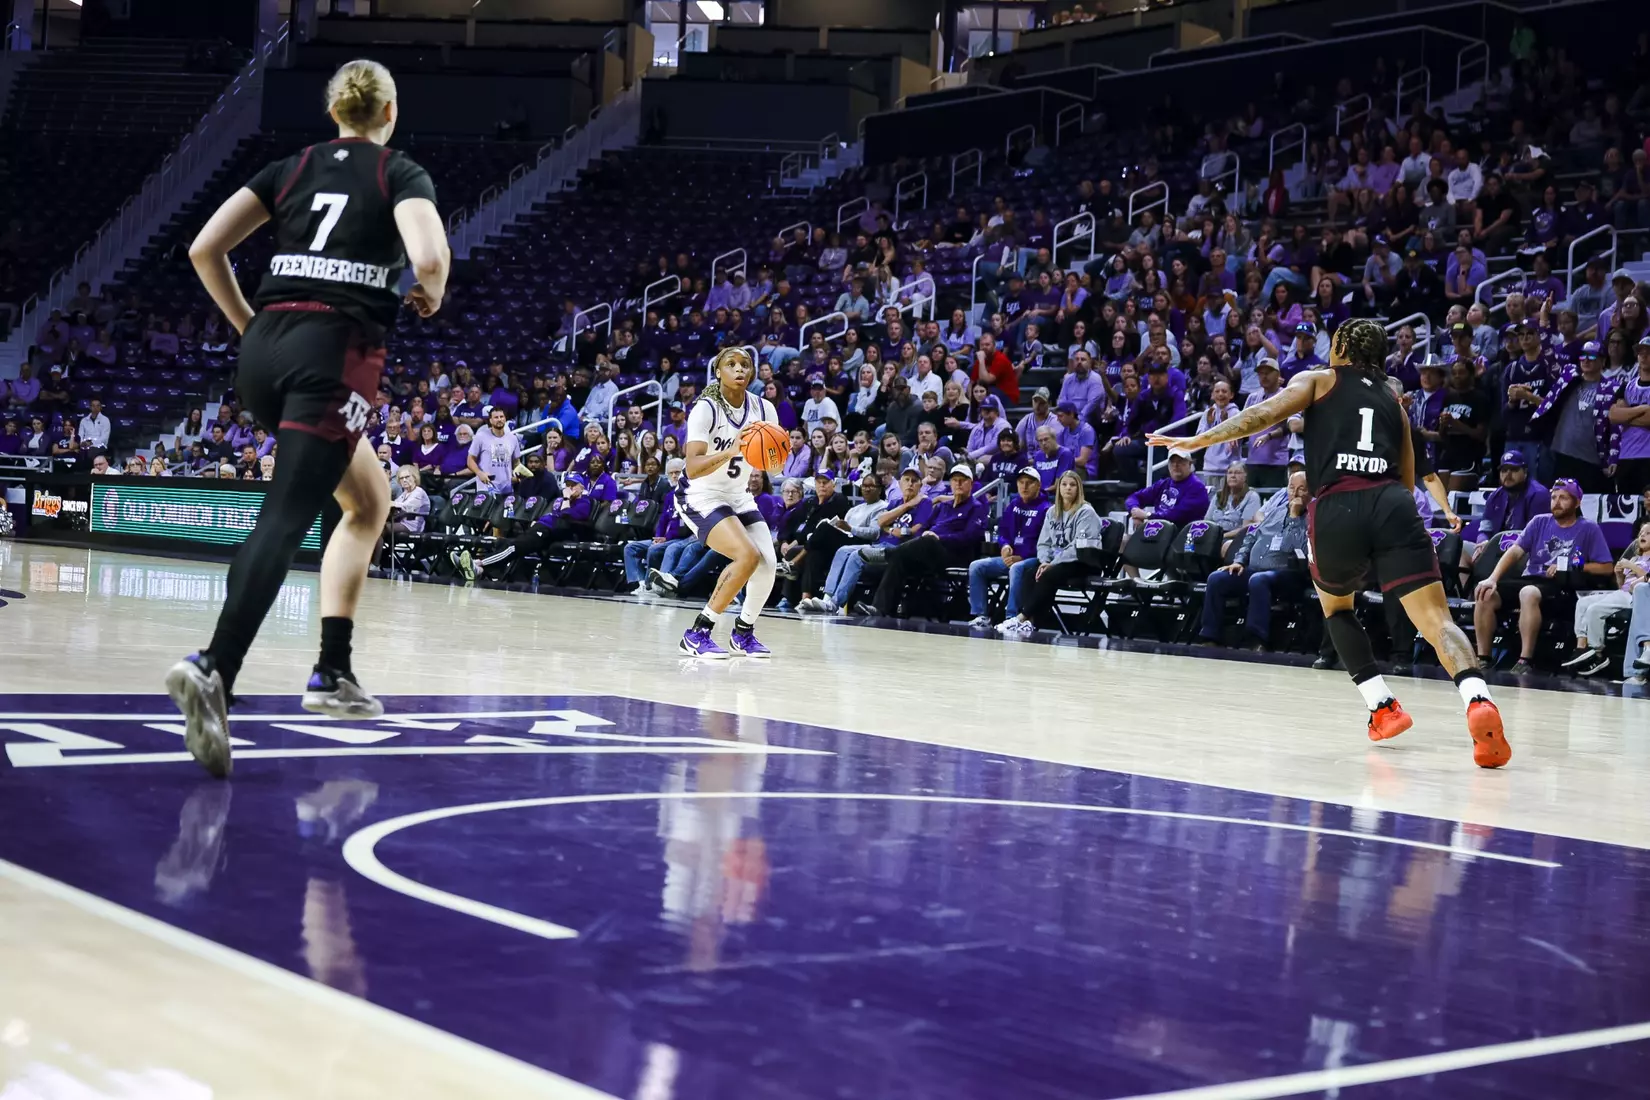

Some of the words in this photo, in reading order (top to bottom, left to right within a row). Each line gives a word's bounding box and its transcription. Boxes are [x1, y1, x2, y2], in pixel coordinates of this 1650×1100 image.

[310, 193, 350, 252] 7
[1356, 407, 1374, 452] 1
[727, 456, 743, 479] 5
[1335, 453, 1388, 474] PRYOR
[33, 490, 61, 517] Briggs
[123, 499, 147, 522] OLD
[150, 501, 213, 527] DOMINION
[1492, 636, 1503, 644] 27
